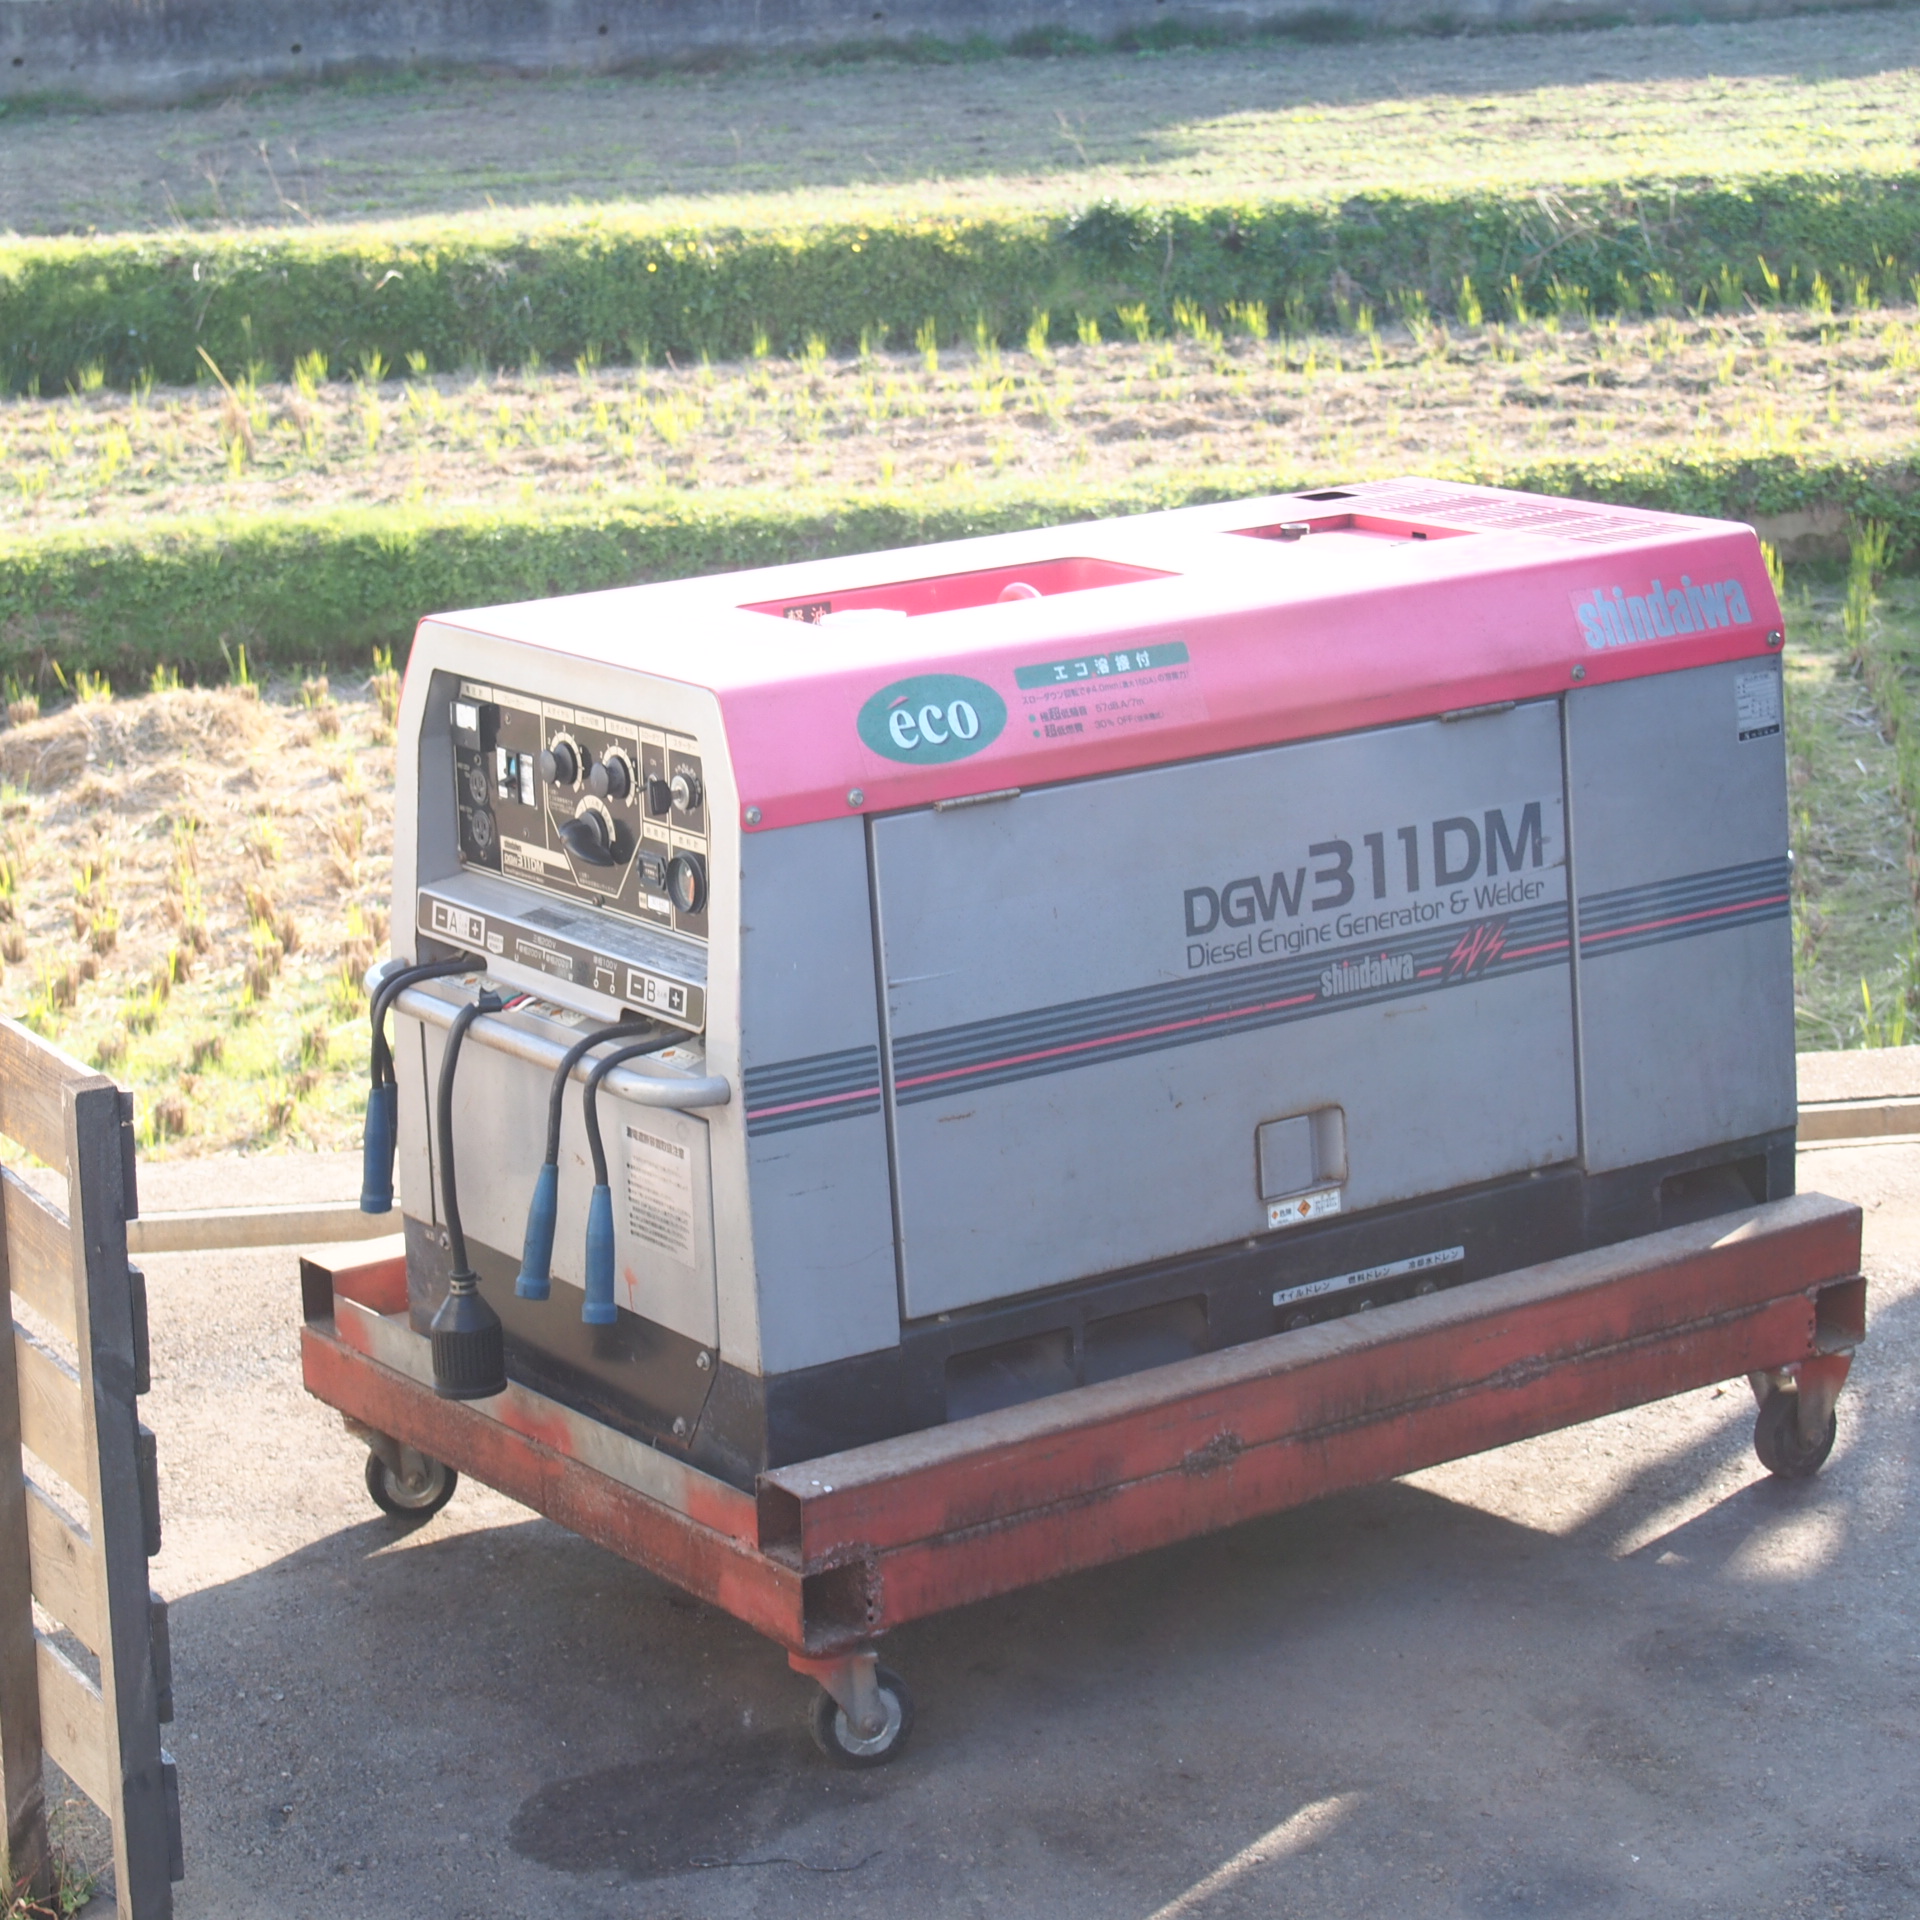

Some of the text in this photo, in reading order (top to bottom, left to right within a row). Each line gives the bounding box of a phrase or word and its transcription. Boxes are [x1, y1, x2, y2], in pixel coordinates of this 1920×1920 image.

[1577, 574, 1753, 650] shindaiwa
[1053, 650, 1151, 681] エコ溶接付
[1094, 717, 1114, 730] 30%
[1184, 801, 1543, 937] DGW311DM
[449, 910, 458, 933] A
[1187, 879, 1545, 969] Diesel Engine Generator & Welder
[647, 979, 656, 1002] B
[1320, 952, 1414, 998] shindaiwa
[1278, 1249, 1459, 1301] オイルドレン 燃料ドレン 冷却水ドレン
